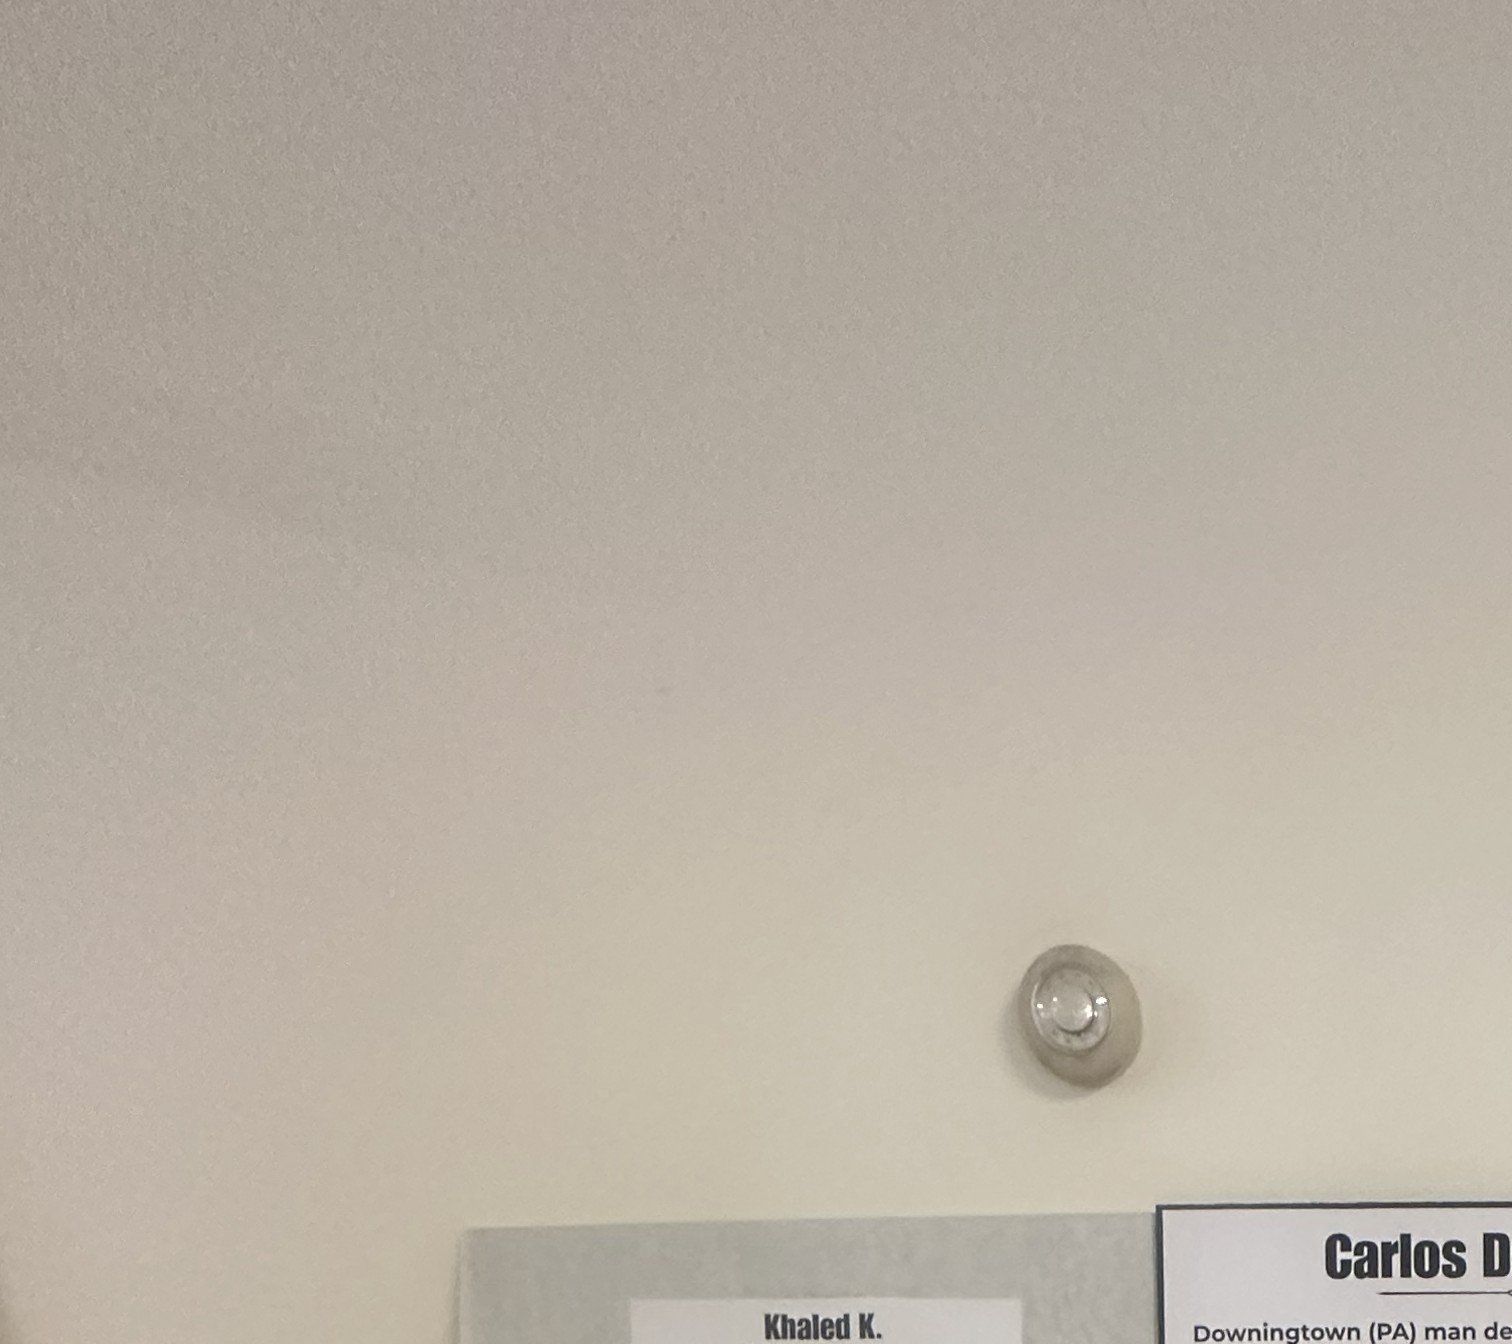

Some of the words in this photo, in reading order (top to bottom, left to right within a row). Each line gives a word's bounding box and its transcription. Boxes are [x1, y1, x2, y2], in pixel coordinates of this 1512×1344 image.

[1324, 1232, 1467, 1280] Carlos
[763, 1312, 851, 1341] Khaled
[857, 1311, 882, 1340] K.
[1368, 1320, 1416, 1344] (PA)
[1424, 1325, 1476, 1341] man
